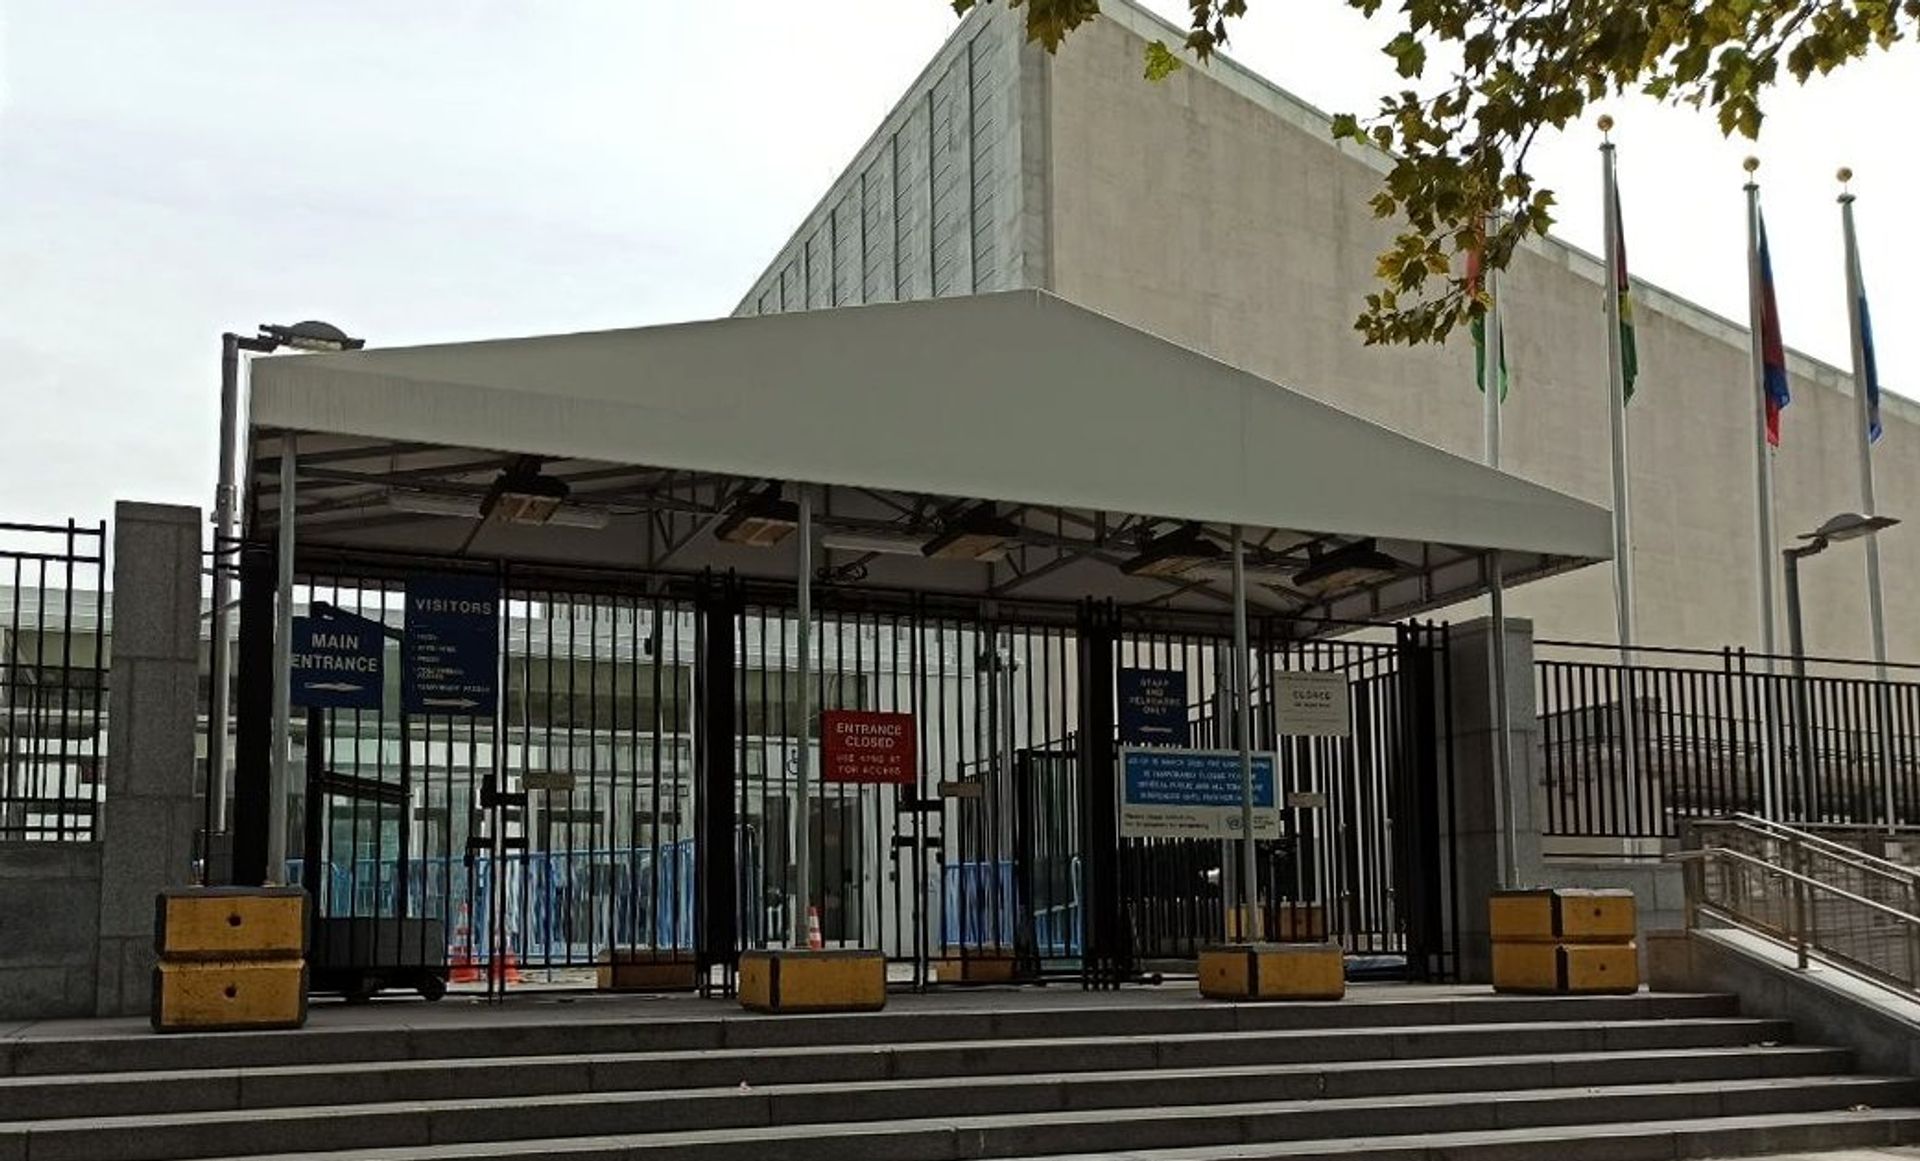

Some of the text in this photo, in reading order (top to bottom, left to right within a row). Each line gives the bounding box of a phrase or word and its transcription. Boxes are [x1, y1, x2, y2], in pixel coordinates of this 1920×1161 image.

[415, 599, 492, 615] VISITORS
[311, 633, 359, 650] MAIN
[291, 653, 378, 673] ENTRANCE
[836, 722, 902, 736] ENTRANCE
[844, 736, 895, 748] CLOSED
